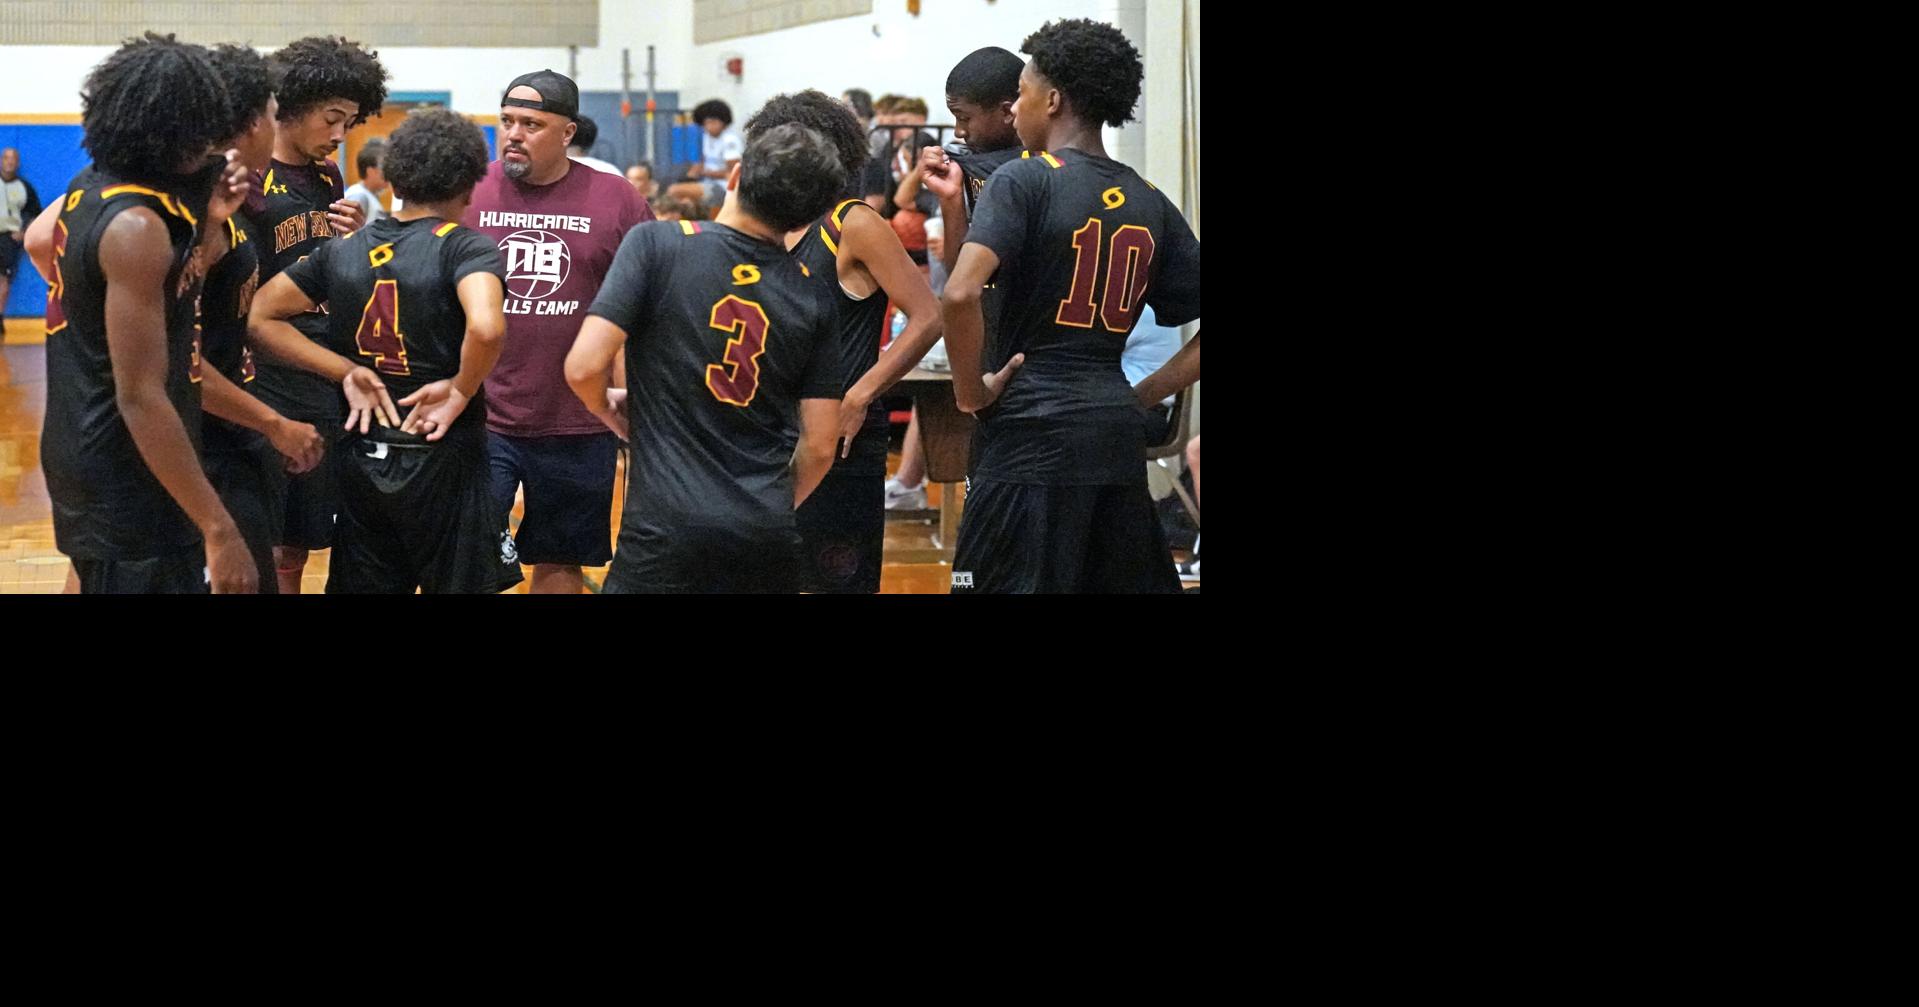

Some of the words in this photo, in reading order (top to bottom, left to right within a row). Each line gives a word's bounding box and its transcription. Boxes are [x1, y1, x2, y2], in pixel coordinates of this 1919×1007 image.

[274, 212, 307, 254] NEW
[479, 211, 591, 233] HURRICANES
[502, 299, 532, 315] LLS
[535, 301, 579, 315] CAMP
[1055, 217, 1155, 333] 10
[355, 280, 411, 376] 4
[705, 294, 770, 407] 3
